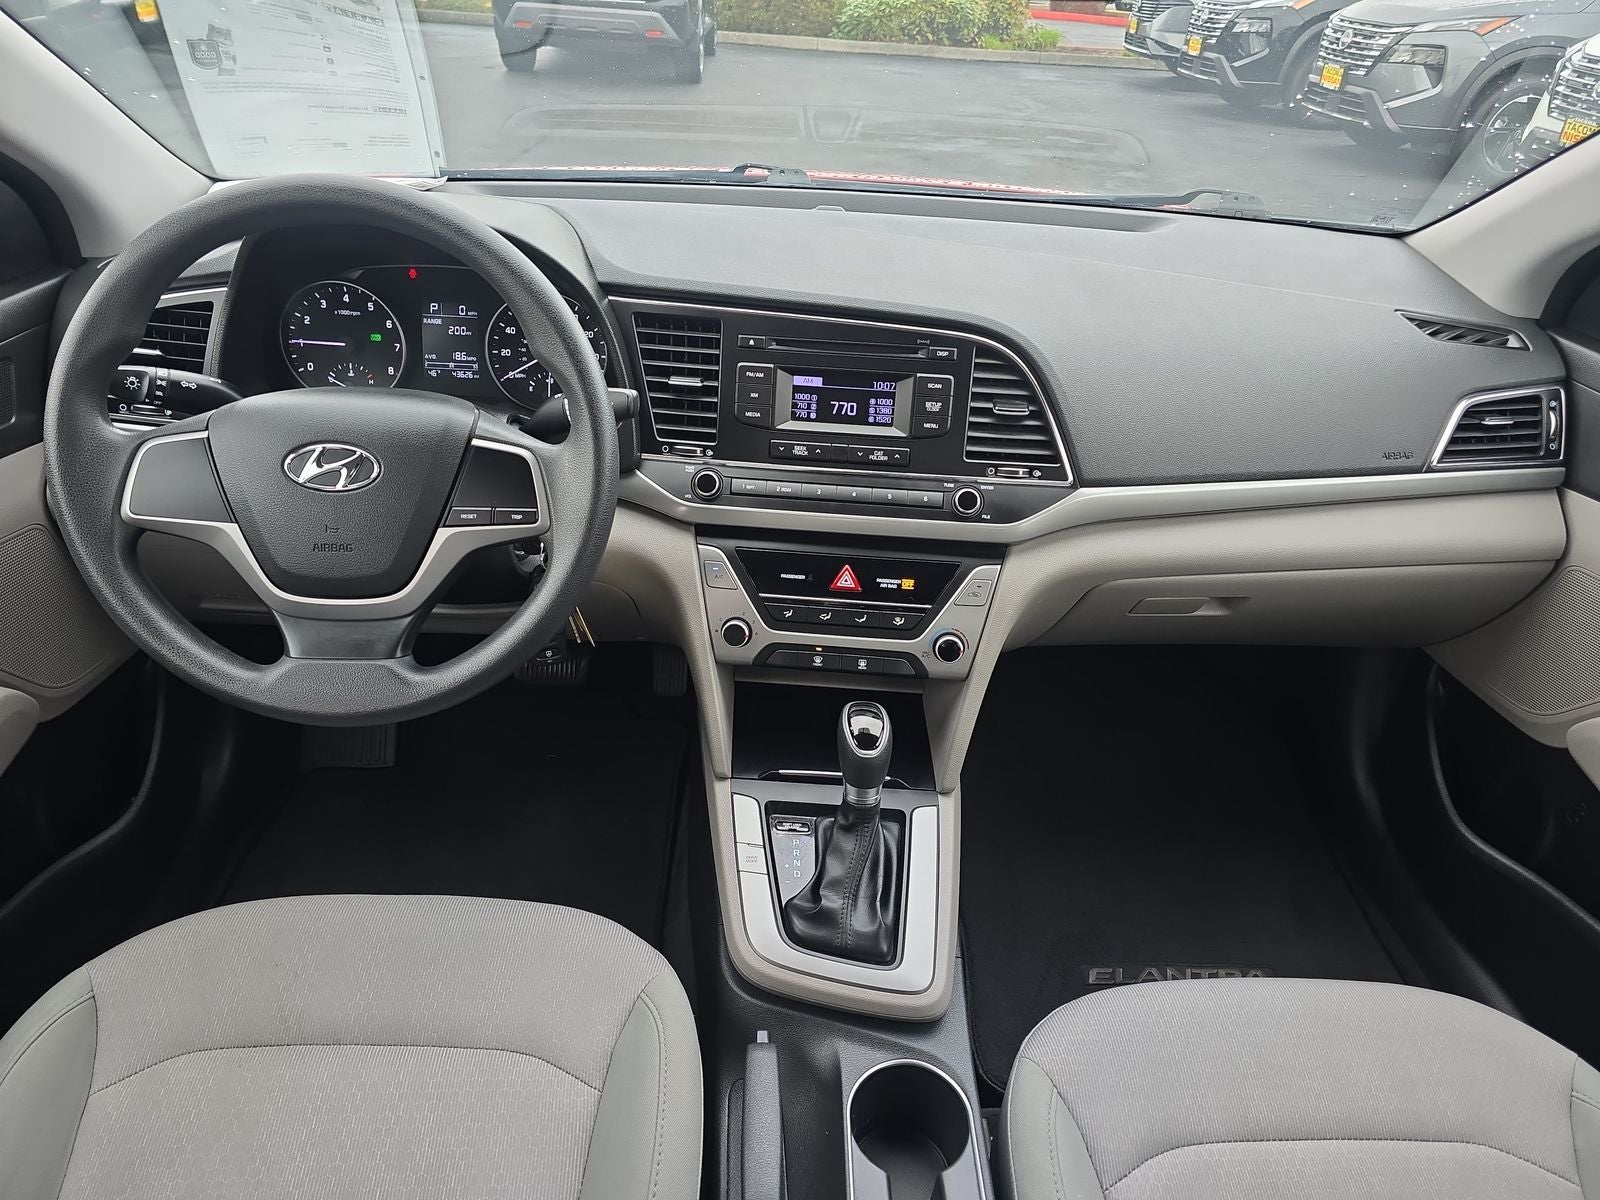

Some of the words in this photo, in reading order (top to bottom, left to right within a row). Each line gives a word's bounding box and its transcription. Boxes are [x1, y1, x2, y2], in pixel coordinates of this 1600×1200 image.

[342, 294, 350, 303] 4
[320, 300, 327, 308] 3
[367, 302, 374, 311] 5
[430, 303, 438, 314] P
[458, 305, 466, 316] 0
[303, 316, 311, 324] 2
[386, 320, 393, 329] 6
[505, 326, 516, 335] 40
[393, 343, 401, 352] 7
[500, 348, 511, 357] 20
[307, 362, 314, 371] 0
[387, 366, 395, 375] 8
[452, 371, 473, 379] 43626
[746, 371, 764, 379] FM/AM
[873, 381, 896, 391] 10:07
[795, 393, 810, 401] 1000
[797, 402, 808, 410] 710
[877, 398, 893, 406] 1000
[830, 401, 857, 416] 770
[1382, 451, 1414, 460] AIRBAG
[313, 543, 353, 552] AIRBAG
[793, 870, 800, 878] D
[1088, 967, 1268, 984] ELANTRA
